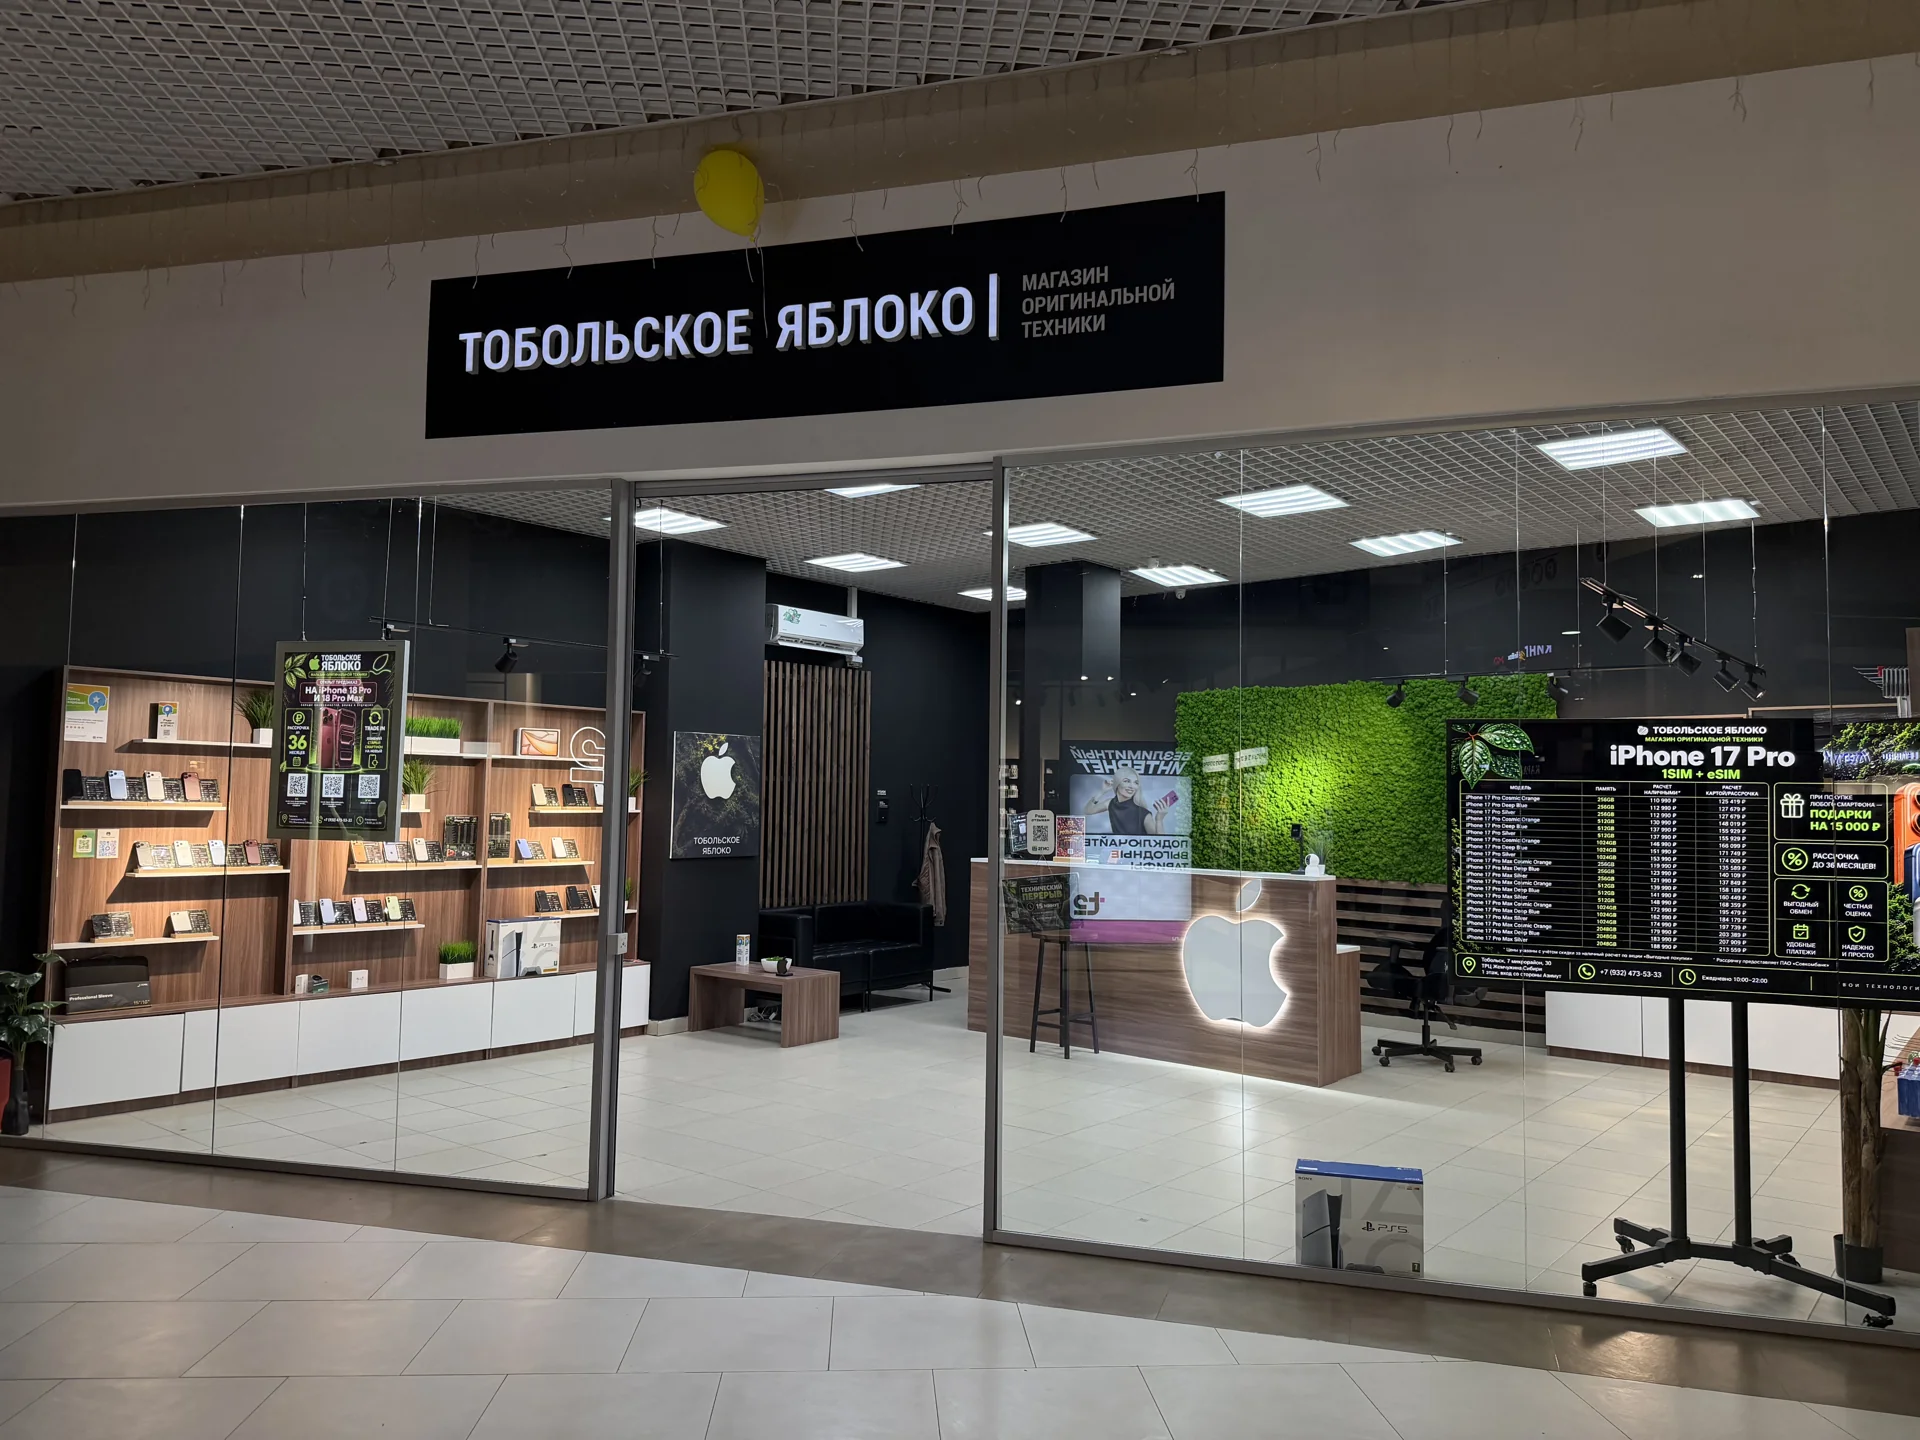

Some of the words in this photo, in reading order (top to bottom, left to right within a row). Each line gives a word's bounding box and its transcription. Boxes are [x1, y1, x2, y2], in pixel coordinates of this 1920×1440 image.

[1021, 265, 1109, 291] МАГАЗИН
[1021, 278, 1175, 315] ОРИГИНАЛЬНОЙ
[459, 308, 753, 375] ТОБОЛЬСКОЕ
[775, 286, 975, 352] ЯБЛОКО
[1021, 314, 1106, 339] ТЕХНИКИ
[321, 662, 361, 671] ЯБЛОКО
[1652, 726, 1722, 734] ТОБОЛЬСКОЕ
[1725, 726, 1767, 734] ЯБЛОКО
[288, 735, 307, 750] 36
[1610, 745, 1704, 766] iPhone
[1710, 746, 1740, 766] 17
[1748, 746, 1795, 767] Pro
[1662, 769, 1692, 779] 1SIM
[1707, 770, 1740, 779] eSIM
[1810, 810, 1872, 820] ПОДАРКИ
[1810, 822, 1828, 831] НА
[1830, 822, 1843, 831] 15
[1845, 822, 1869, 831] 000
[694, 836, 740, 845] ТОБОЛЬСКОЕ
[702, 847, 731, 855] ЯБЛОКО
[1812, 853, 1859, 861] РАССРОЧКА
[1021, 884, 1062, 893] ТЕХНИЧЕСКИЙ
[1022, 891, 1062, 900] ПЕРЕРЫВ
[1378, 1224, 1408, 1233] PS5
